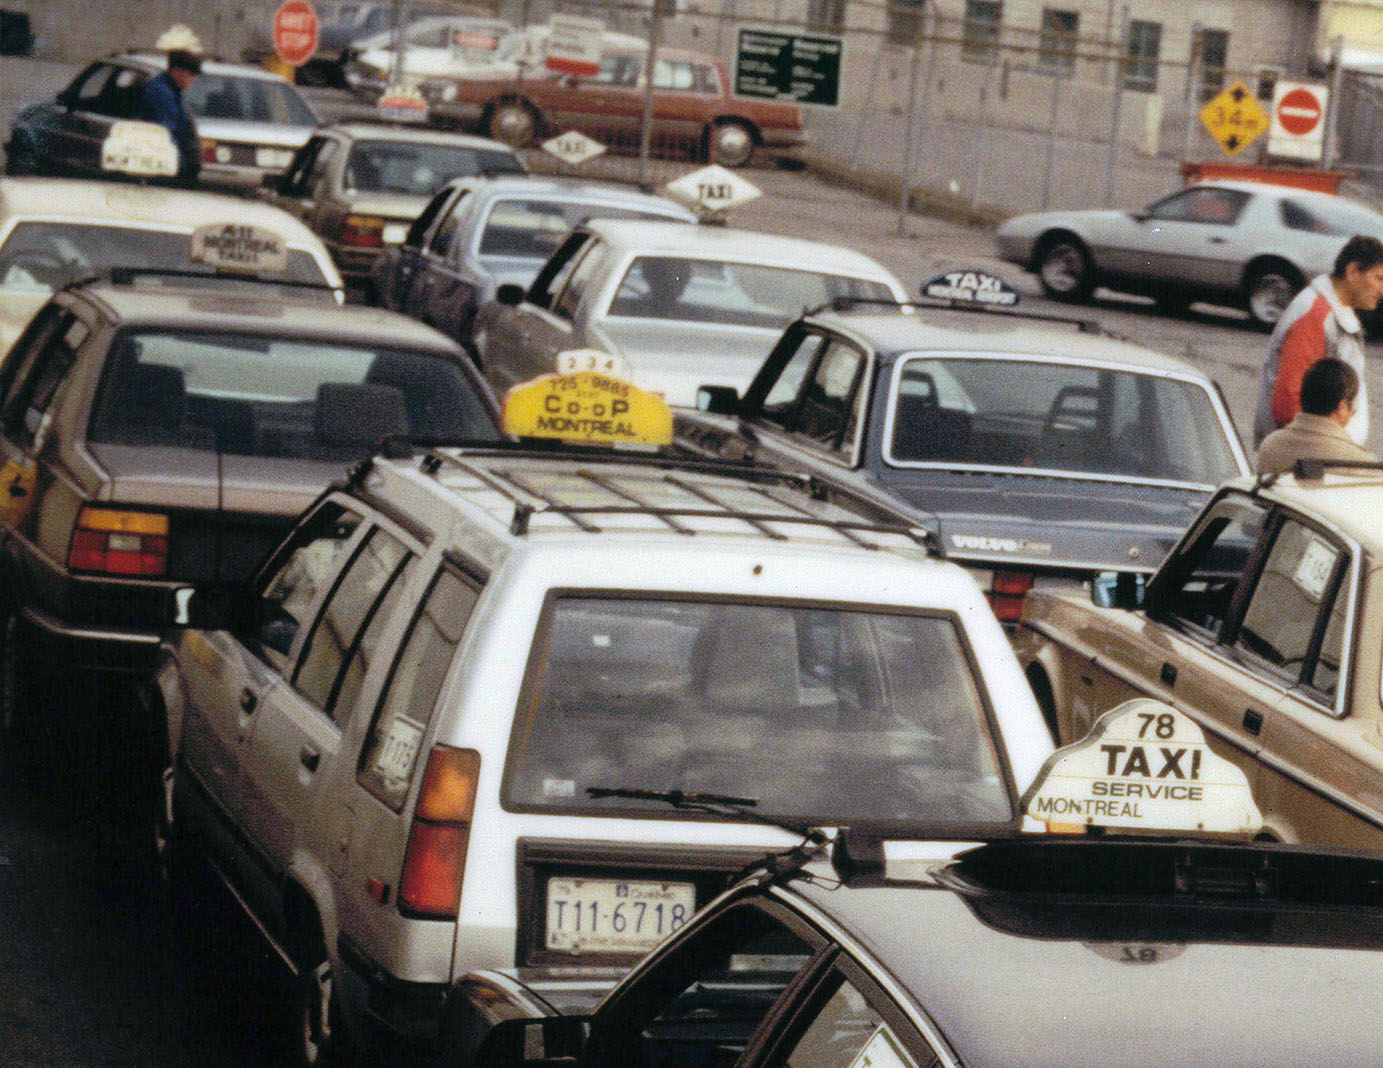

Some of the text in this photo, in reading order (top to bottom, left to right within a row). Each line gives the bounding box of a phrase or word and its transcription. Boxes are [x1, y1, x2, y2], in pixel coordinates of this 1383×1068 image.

[697, 183, 733, 200] TAXI
[203, 235, 282, 255] MONTREAL
[945, 271, 1002, 293] TAXI
[537, 416, 638, 437] MONTREAL
[951, 534, 1018, 552] VOLVO
[1137, 713, 1176, 740] 78
[1100, 744, 1203, 781] TAXI
[1091, 781, 1204, 802] SERVICE
[1036, 797, 1144, 819] MONTREAL
